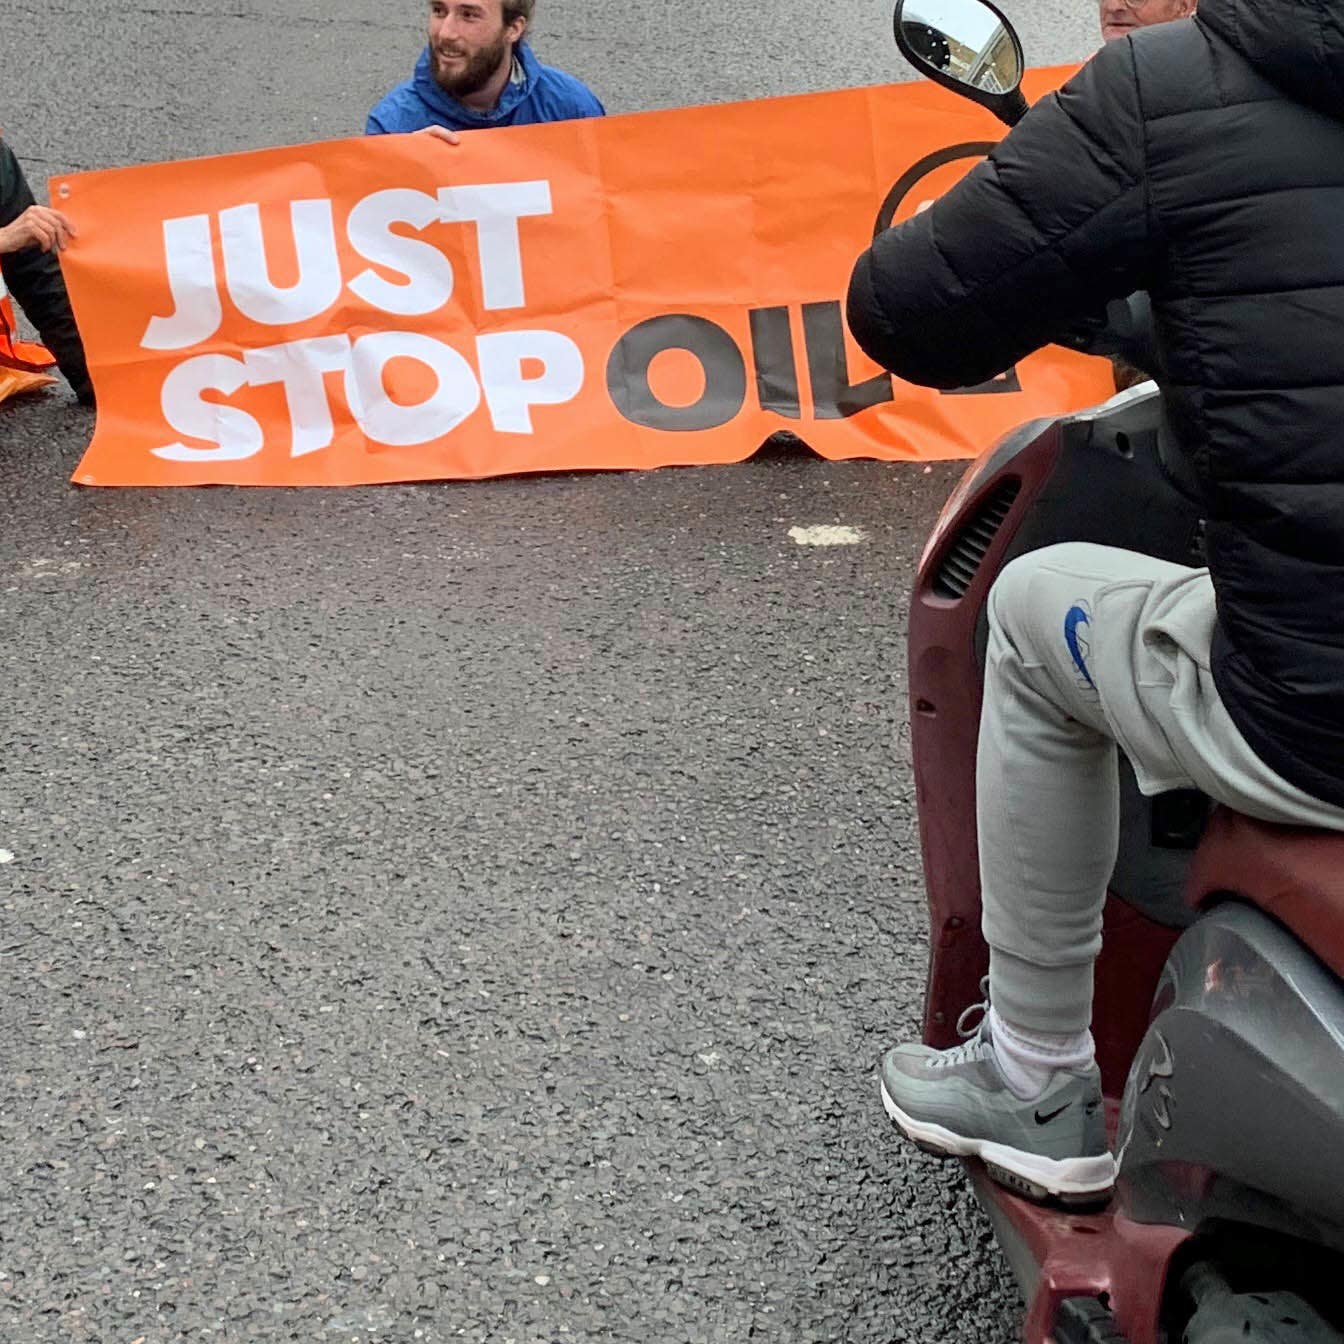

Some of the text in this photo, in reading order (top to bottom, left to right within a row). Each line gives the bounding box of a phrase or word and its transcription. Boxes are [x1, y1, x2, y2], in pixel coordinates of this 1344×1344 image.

[140, 179, 553, 352] JUST
[150, 300, 893, 464] STOP OIL
